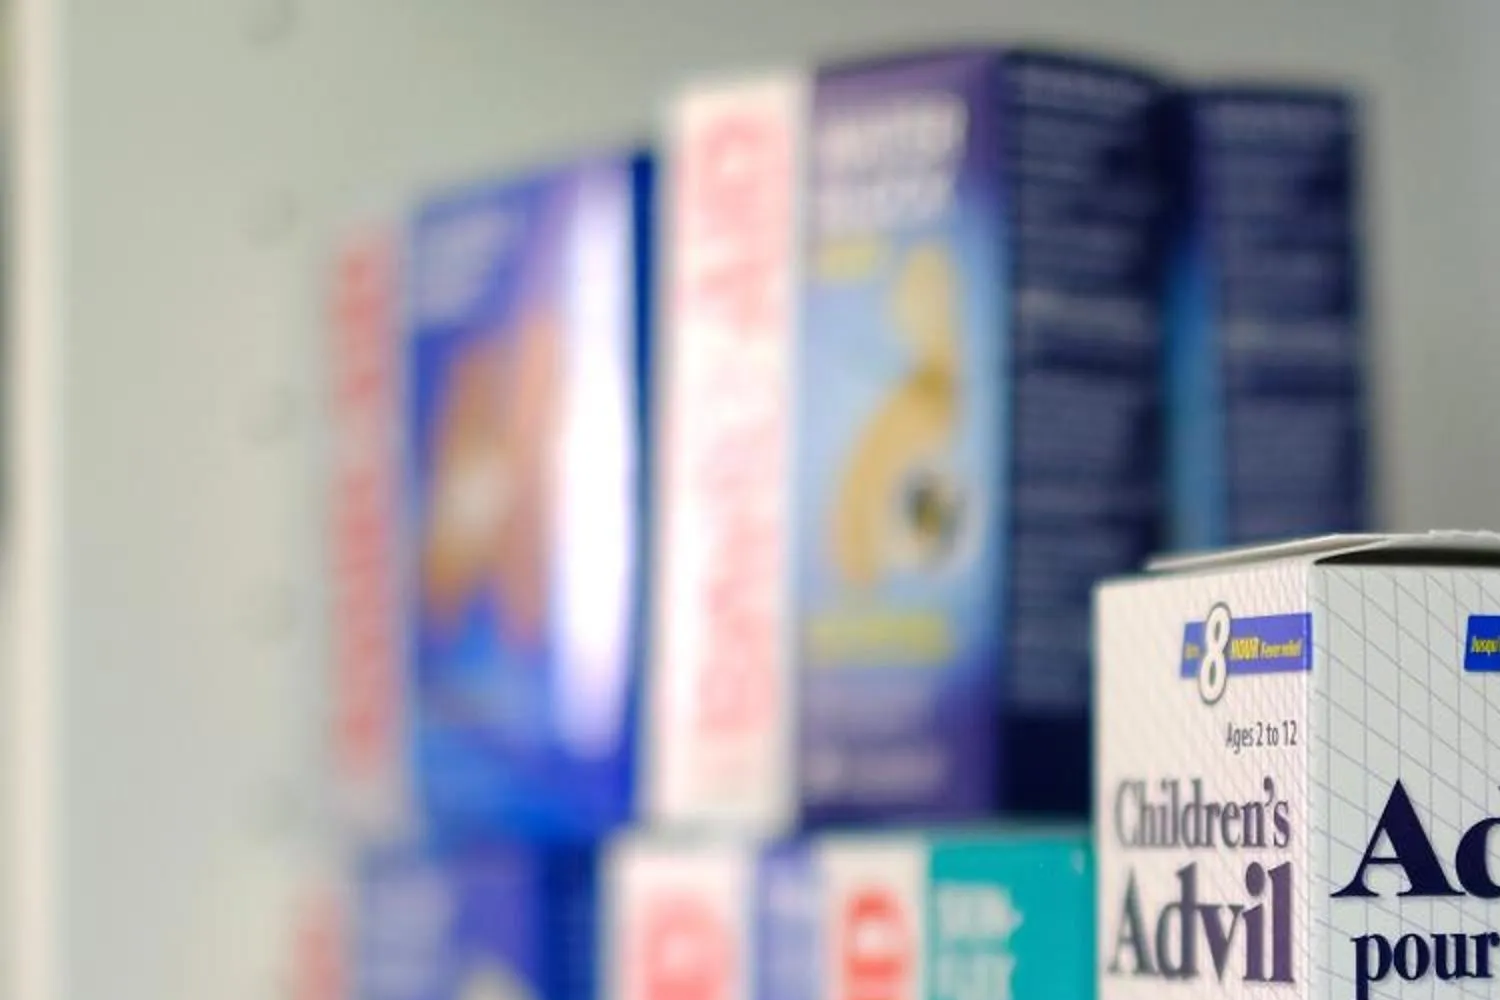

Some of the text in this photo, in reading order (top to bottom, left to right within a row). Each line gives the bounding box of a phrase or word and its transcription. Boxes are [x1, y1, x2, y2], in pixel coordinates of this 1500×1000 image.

[1198, 601, 1231, 705] 8
[1225, 720, 1298, 754] Ages 2 to 12
[1114, 776, 1291, 849] Children's
[1107, 860, 1295, 983] Advil
